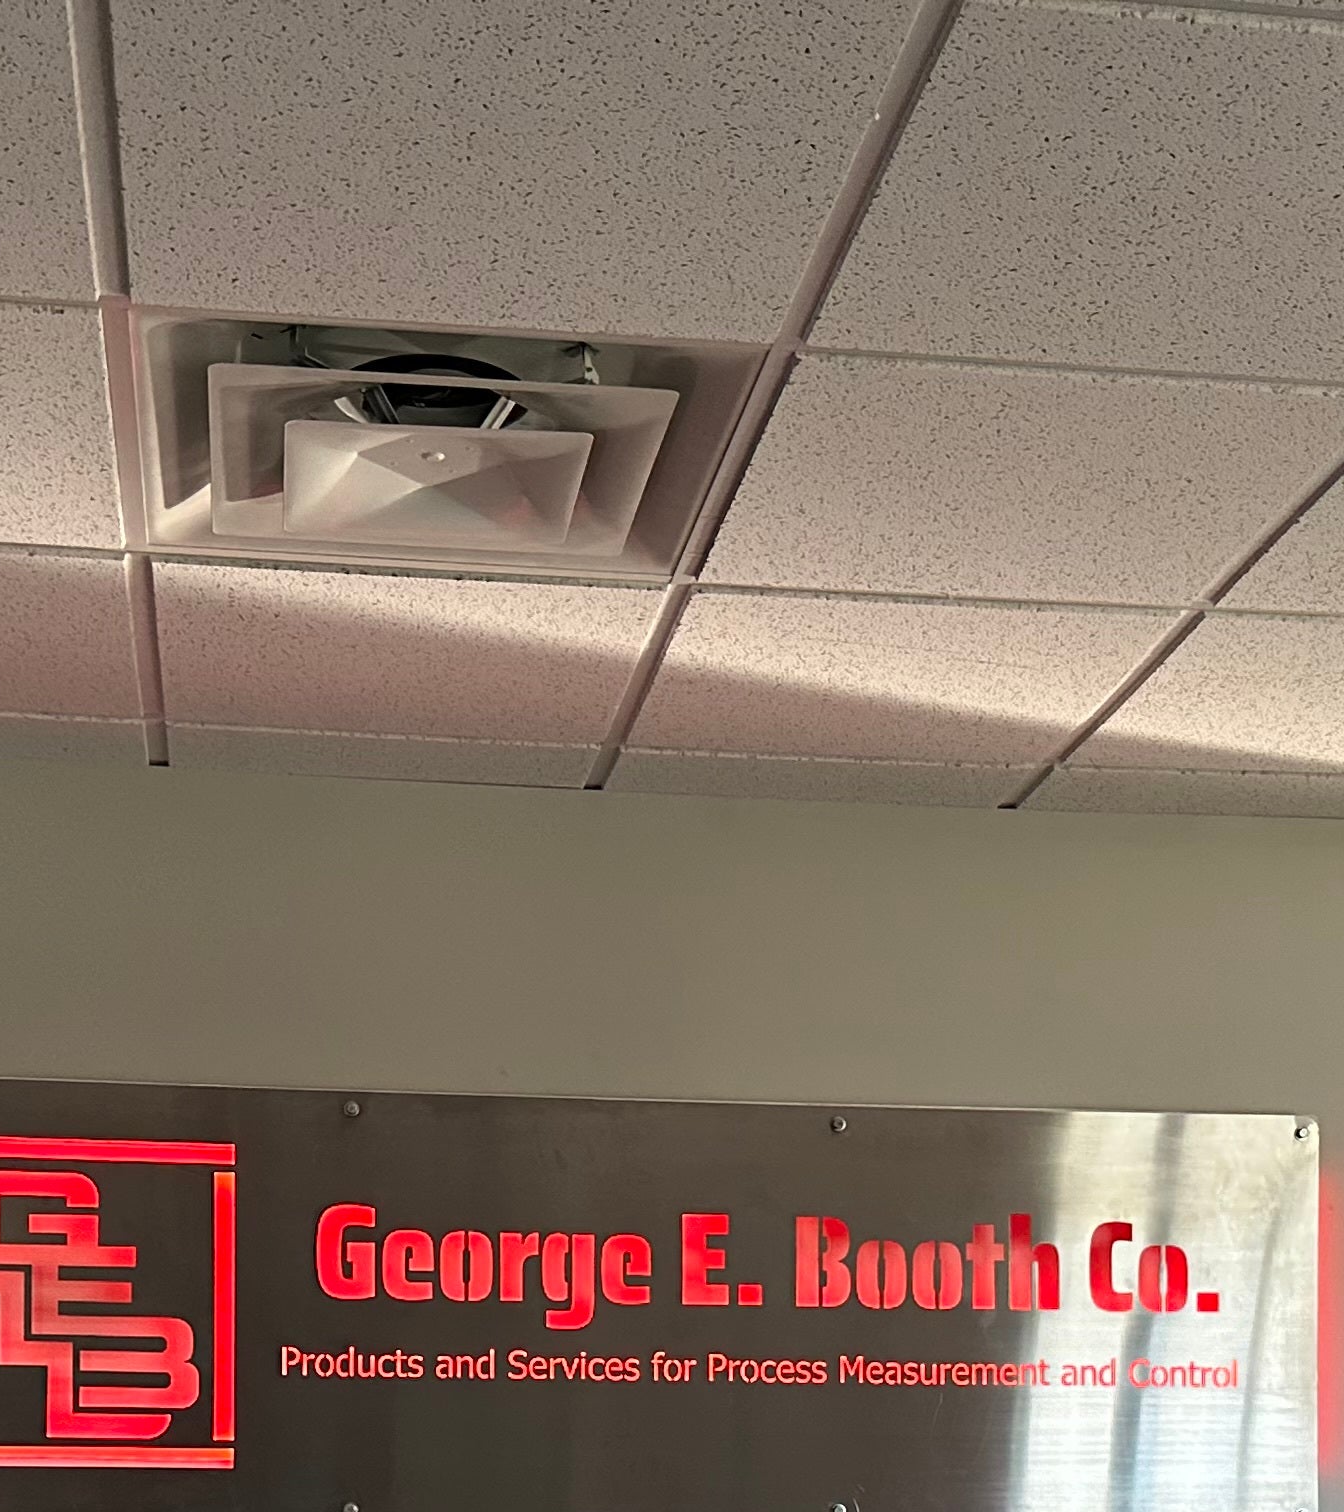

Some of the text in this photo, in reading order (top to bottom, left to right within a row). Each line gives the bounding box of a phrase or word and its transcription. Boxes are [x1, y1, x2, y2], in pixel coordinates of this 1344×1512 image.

[315, 1202, 1220, 1331] George E. Booth Co.
[280, 1345, 1238, 1389] Products and Services for Process Measurement and Control
